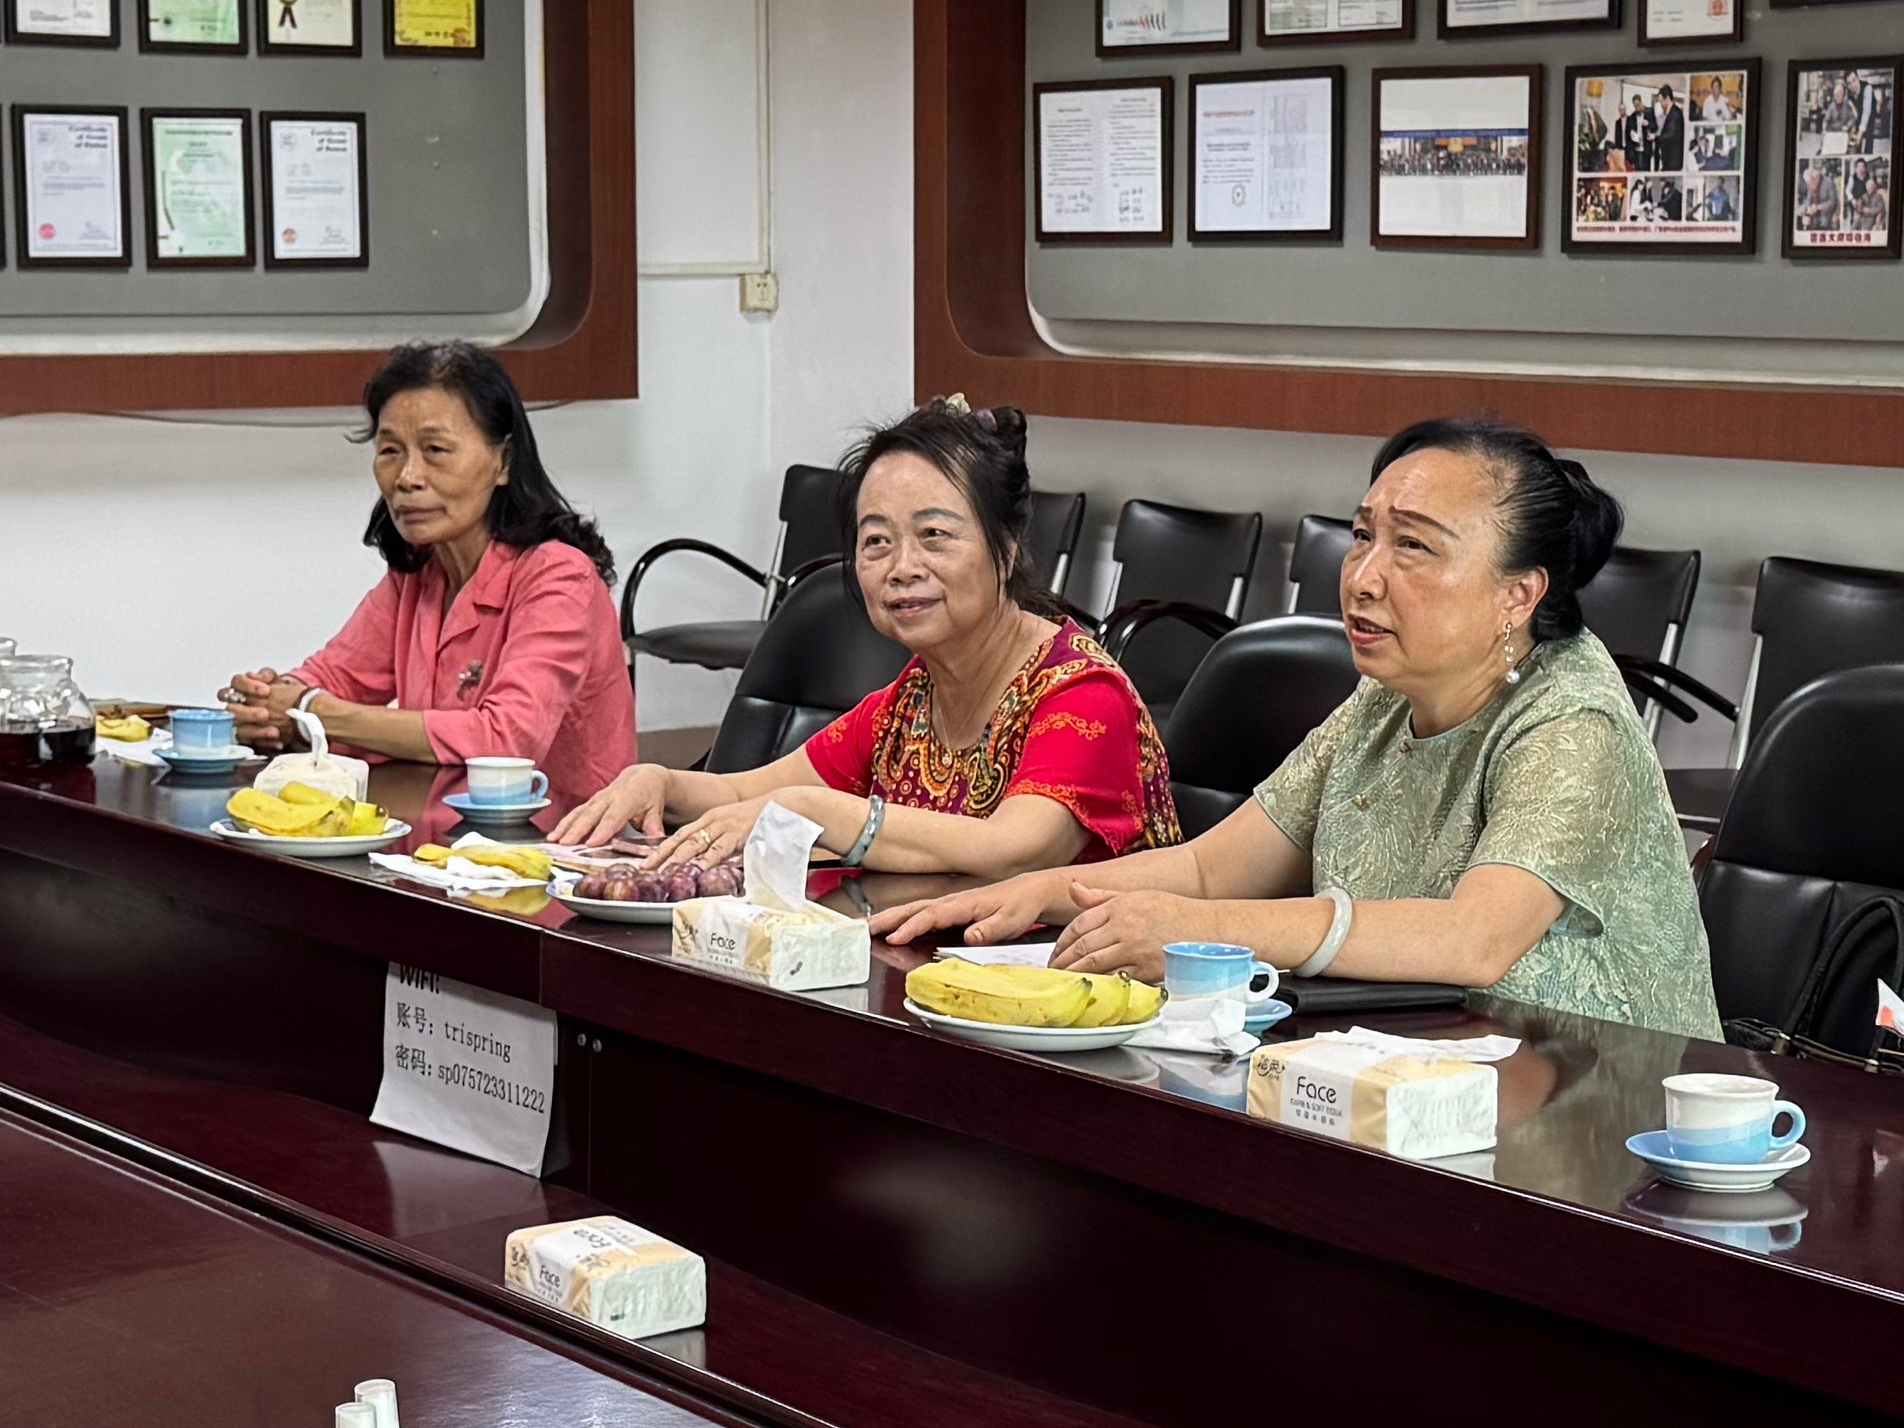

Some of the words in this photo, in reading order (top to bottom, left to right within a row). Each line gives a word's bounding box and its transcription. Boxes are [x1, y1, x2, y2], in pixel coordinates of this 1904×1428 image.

[709, 932, 736, 951] Face
[444, 1021, 512, 1064] trispring
[438, 1063, 545, 1114] sp075723311222
[1296, 1075, 1337, 1104] Face
[539, 1264, 561, 1288] Face
